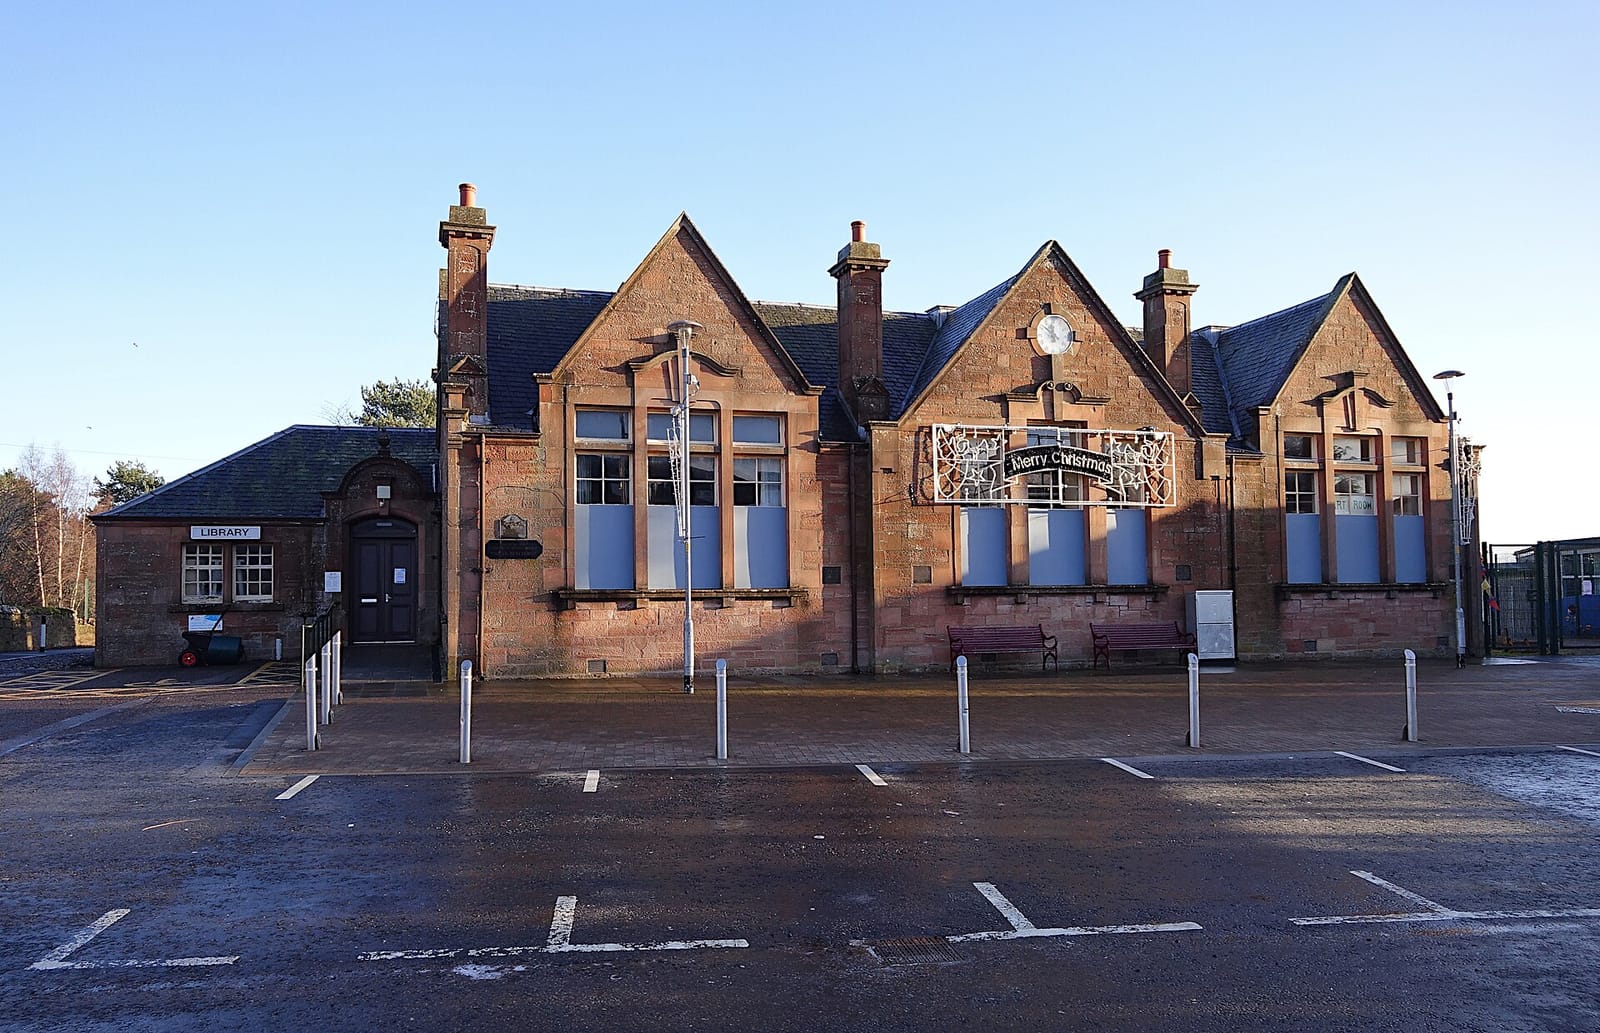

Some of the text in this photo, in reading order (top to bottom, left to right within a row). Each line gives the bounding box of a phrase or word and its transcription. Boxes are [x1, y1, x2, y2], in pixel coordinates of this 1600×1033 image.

[1011, 451, 1112, 474] Merry Christmas
[1336, 500, 1372, 510] RT ROOM
[201, 528, 249, 537] LIBRARY
